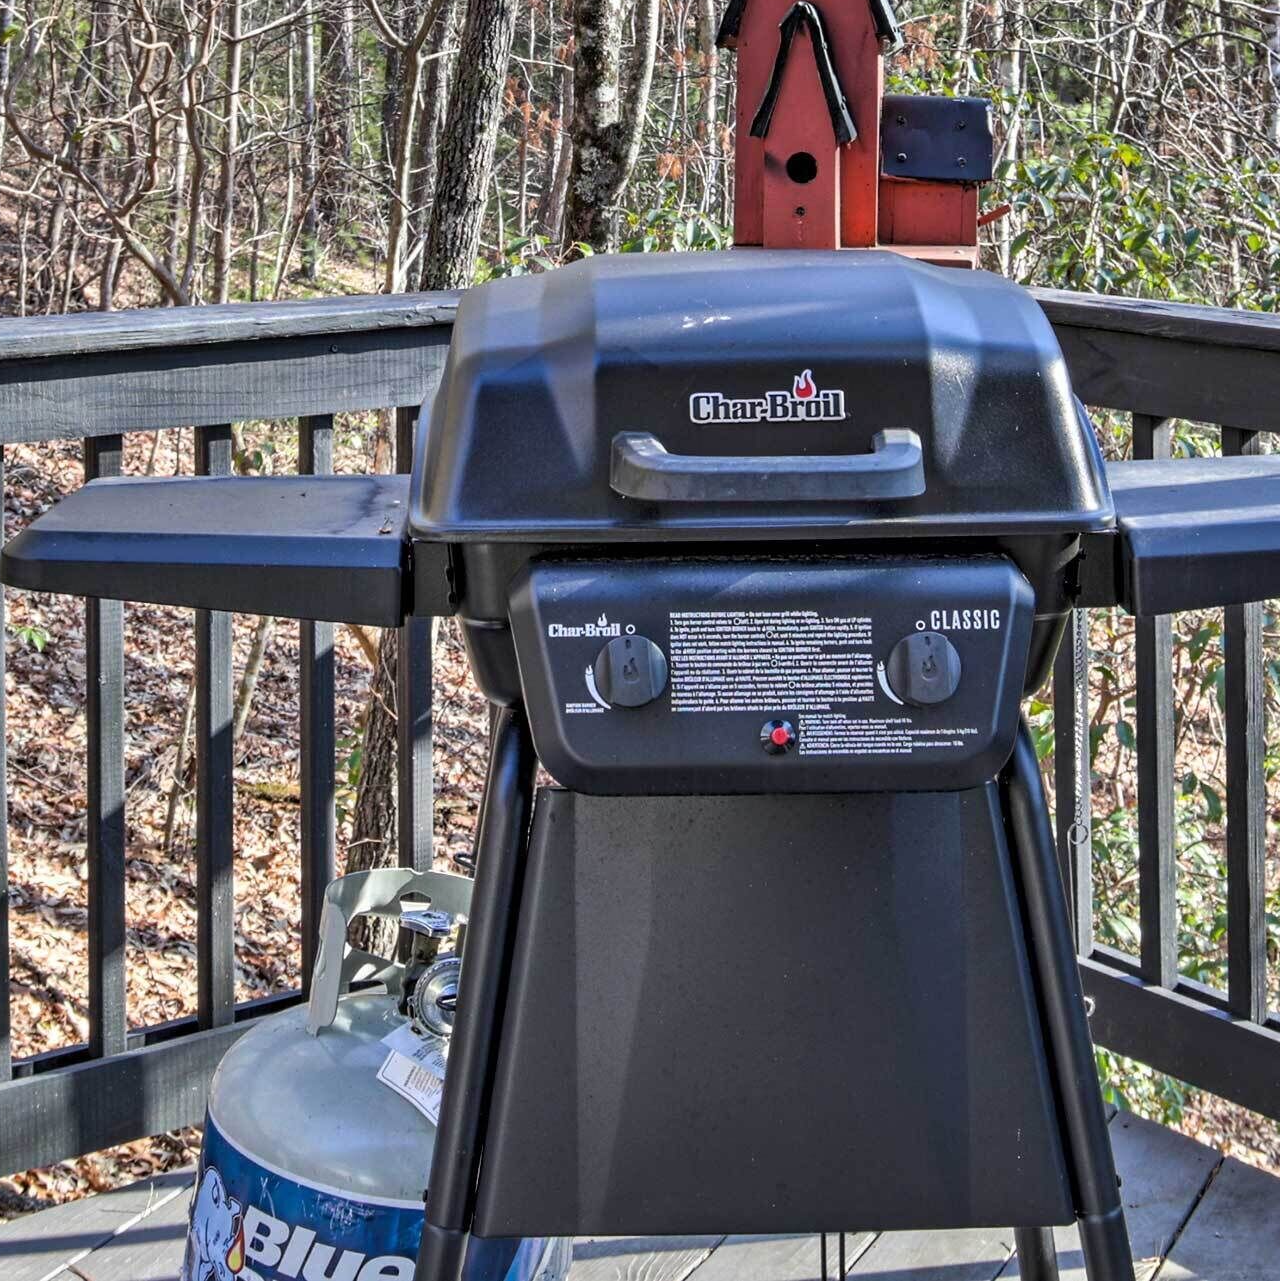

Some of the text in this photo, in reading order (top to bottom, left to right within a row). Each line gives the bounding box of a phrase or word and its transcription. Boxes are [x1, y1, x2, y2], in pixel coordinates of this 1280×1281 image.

[691, 389, 846, 422] Char-Broil
[548, 623, 621, 637] Char-Broil
[931, 609, 1000, 630] CLASSIC
[242, 1204, 417, 1281] Blue
